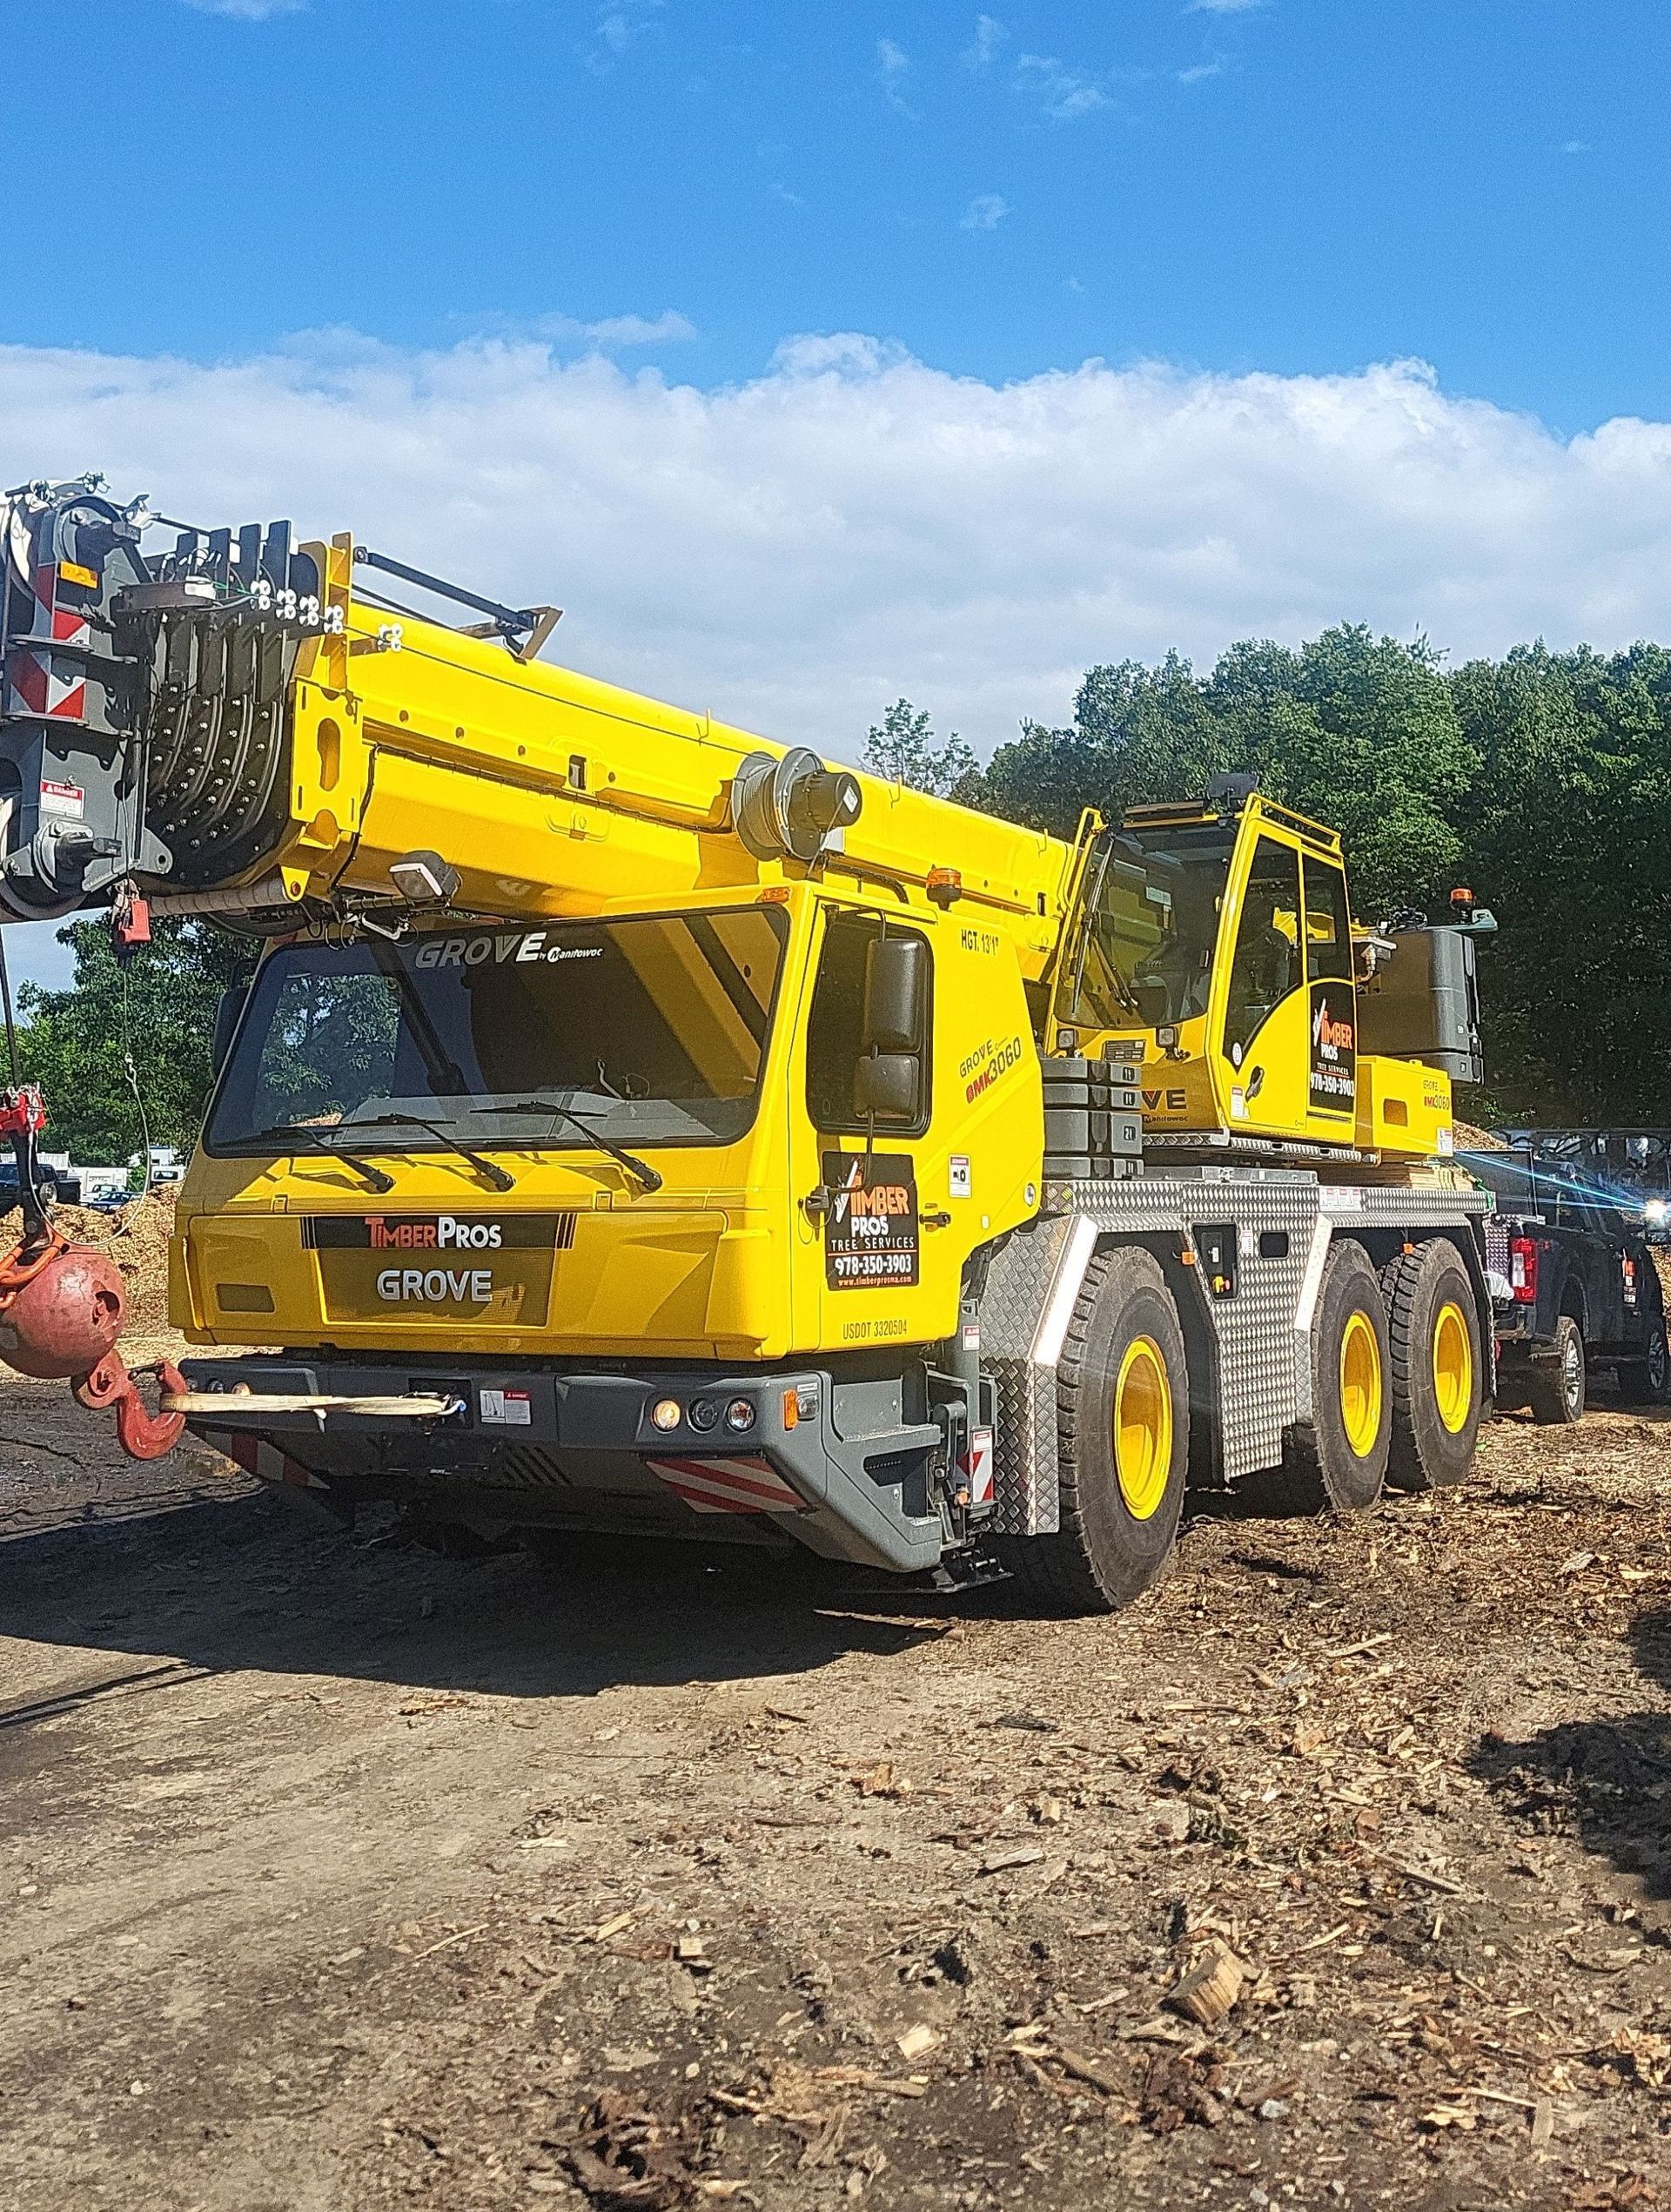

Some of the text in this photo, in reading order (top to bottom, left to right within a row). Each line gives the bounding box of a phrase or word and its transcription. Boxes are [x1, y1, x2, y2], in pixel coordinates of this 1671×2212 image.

[415, 931, 547, 969] GROVE
[547, 946, 603, 963] Manitowoc
[961, 929, 979, 952] HGT.
[959, 1039, 993, 1079] GROVE
[1320, 1043, 1339, 1061] PROS
[438, 1216, 502, 1248] PROS
[850, 1215, 889, 1238] PROS
[831, 1236, 915, 1252] TREE SERVICES
[835, 1254, 912, 1276] 978-350-3903
[376, 1269, 493, 1302] GROVE
[842, 1322, 871, 1340] USDOT
